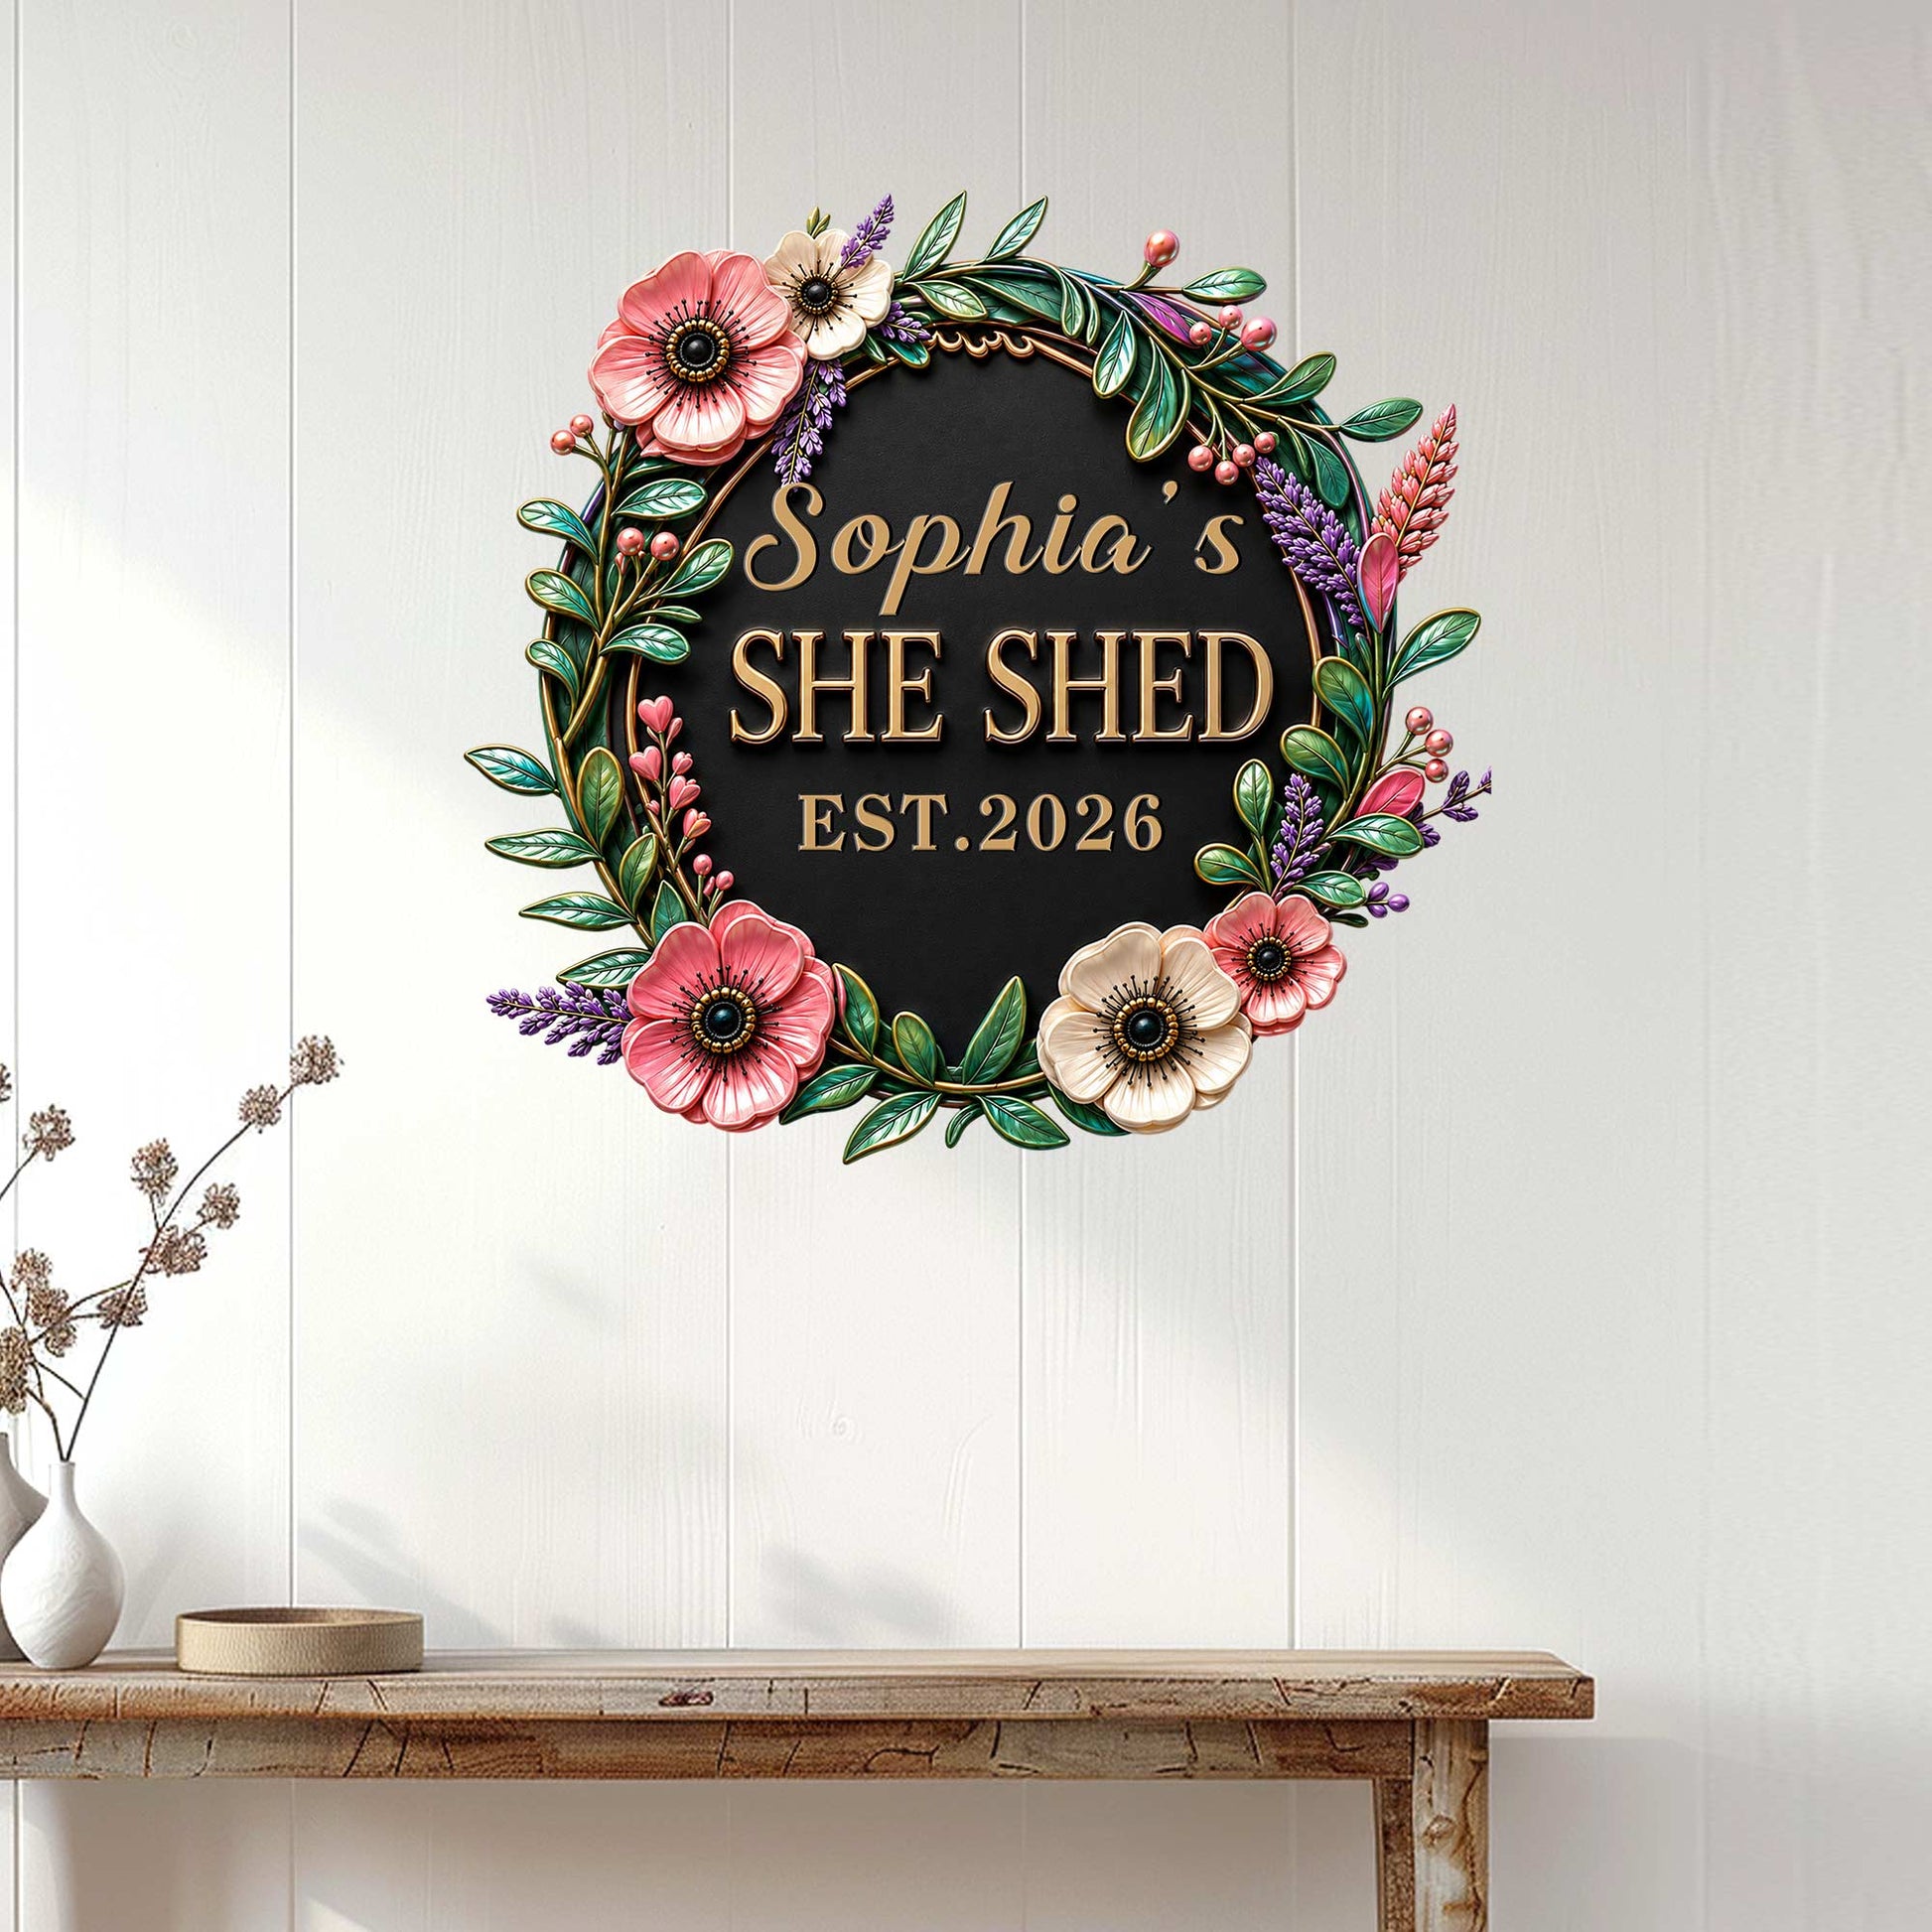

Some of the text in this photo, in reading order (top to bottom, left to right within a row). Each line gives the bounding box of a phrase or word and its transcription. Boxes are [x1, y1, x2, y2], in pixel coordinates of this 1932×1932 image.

[730, 627, 1275, 745] SHE SHED
[797, 793, 1164, 853] EST.2026
